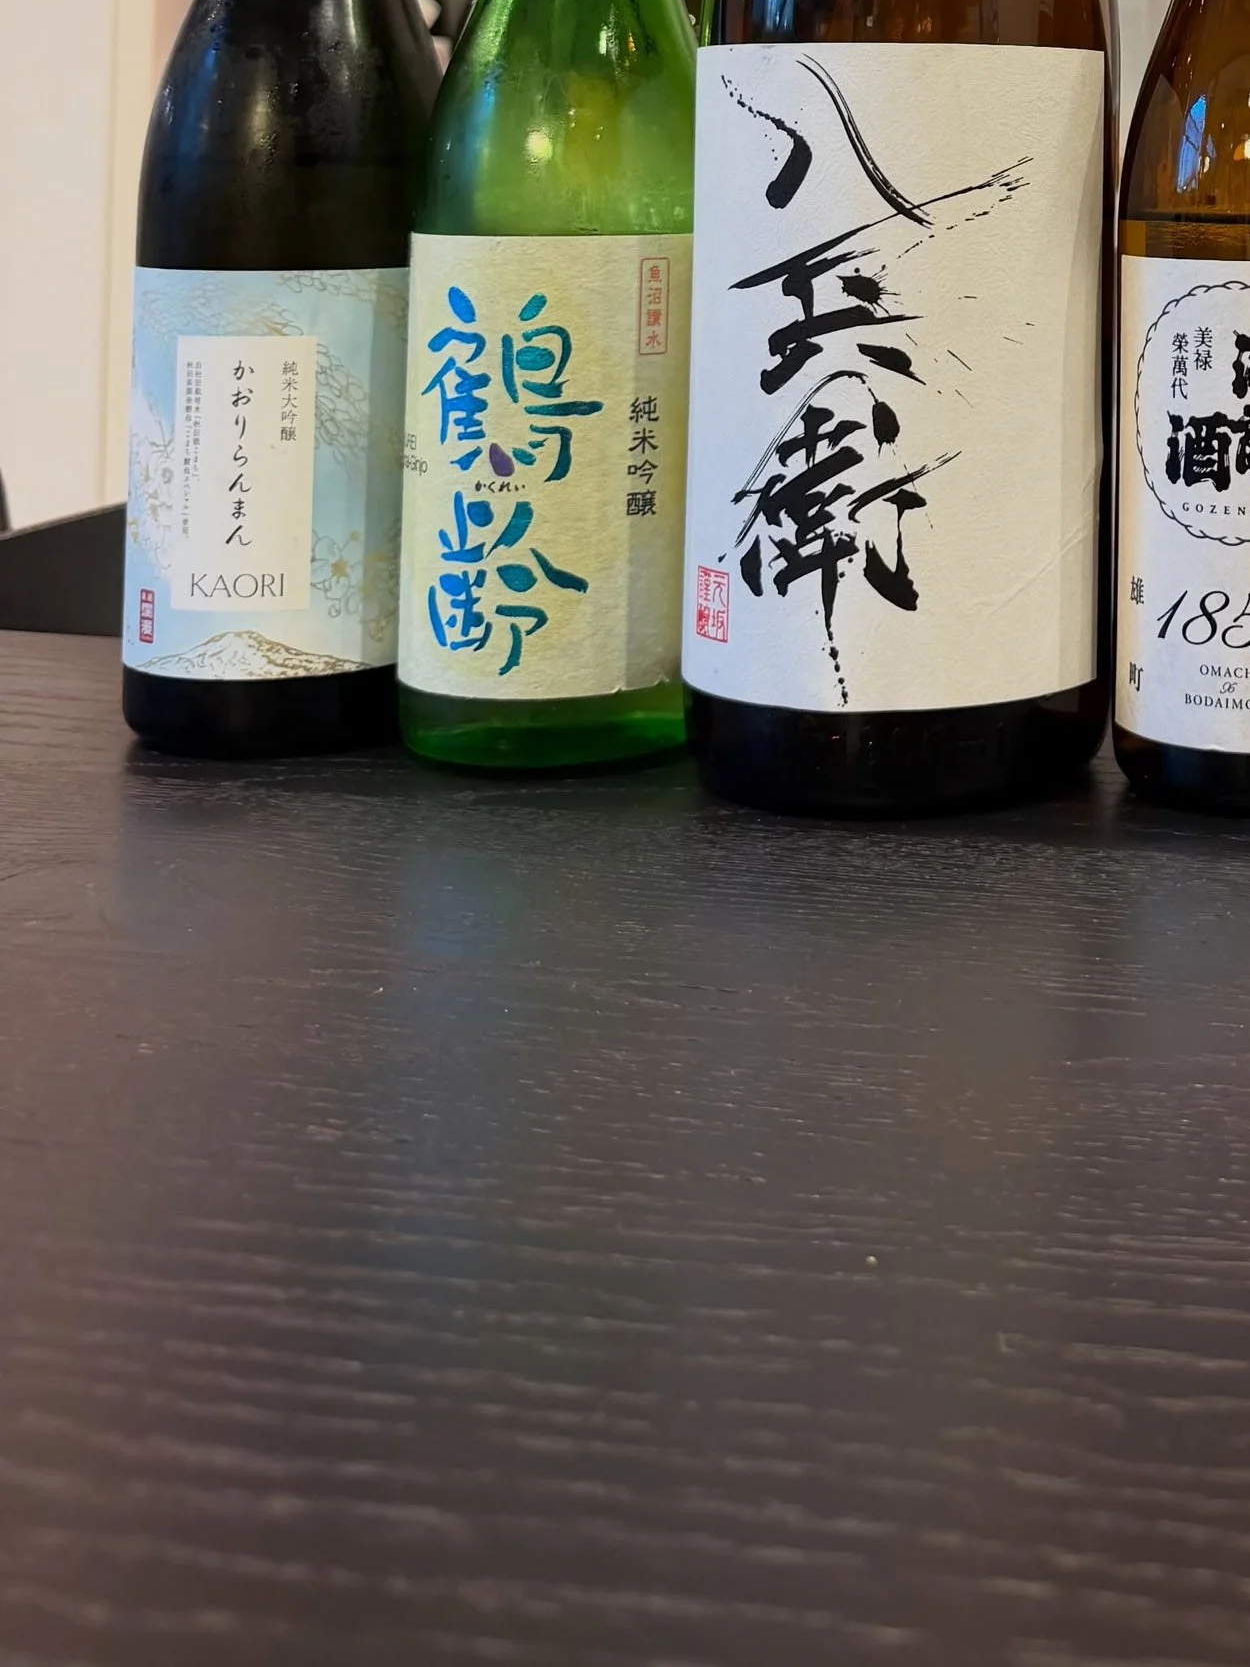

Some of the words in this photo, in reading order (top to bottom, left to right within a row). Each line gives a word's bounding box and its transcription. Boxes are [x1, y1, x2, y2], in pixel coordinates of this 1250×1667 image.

[722, 53, 1034, 707] 八兵衛
[1193, 326, 1213, 372] 美禄
[280, 360, 299, 442] 純米大吟醸
[224, 359, 255, 547] かおりらんまん
[475, 480, 526, 493] かくれい
[626, 395, 660, 517] 純米吟醸
[189, 572, 286, 598] KAORI
[1129, 576, 1145, 692] 雄町
